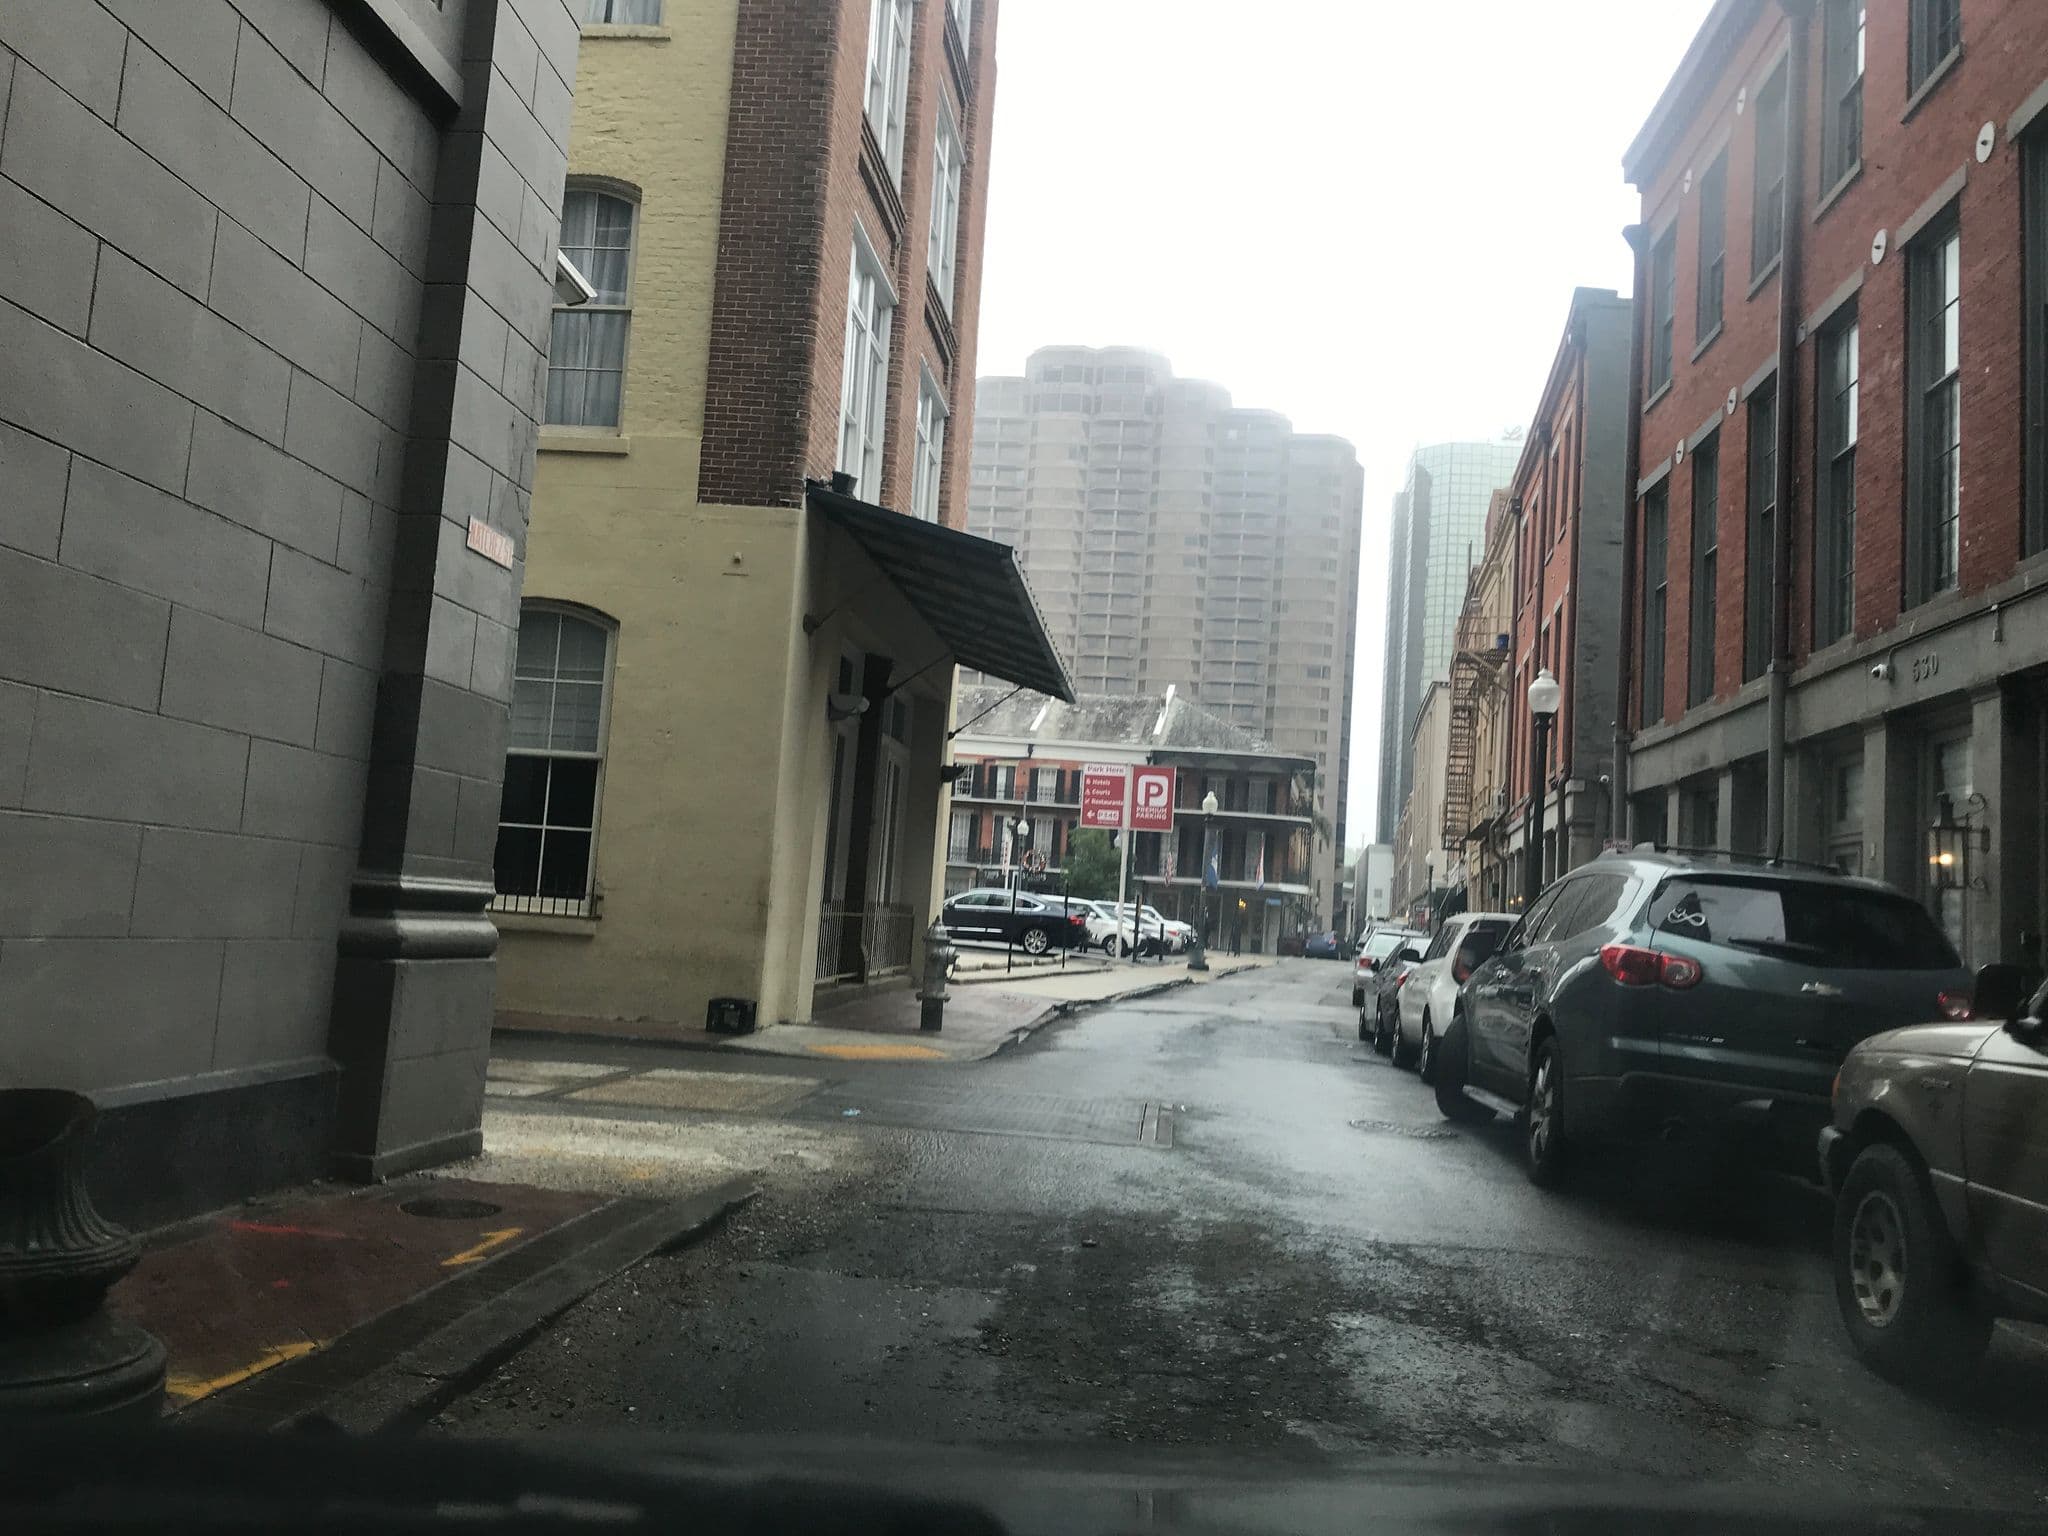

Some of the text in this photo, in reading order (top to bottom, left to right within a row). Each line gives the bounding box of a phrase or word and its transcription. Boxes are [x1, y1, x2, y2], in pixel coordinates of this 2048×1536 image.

[1913, 654, 1939, 682] 530
[1087, 765, 1124, 774] Park Here
[1092, 778, 1111, 786] Hotels
[1092, 788, 1111, 796] Courts
[1091, 798, 1124, 806] Restaurants
[1136, 806, 1168, 814] PREMIUM
[1135, 812, 1167, 820] PARKING
